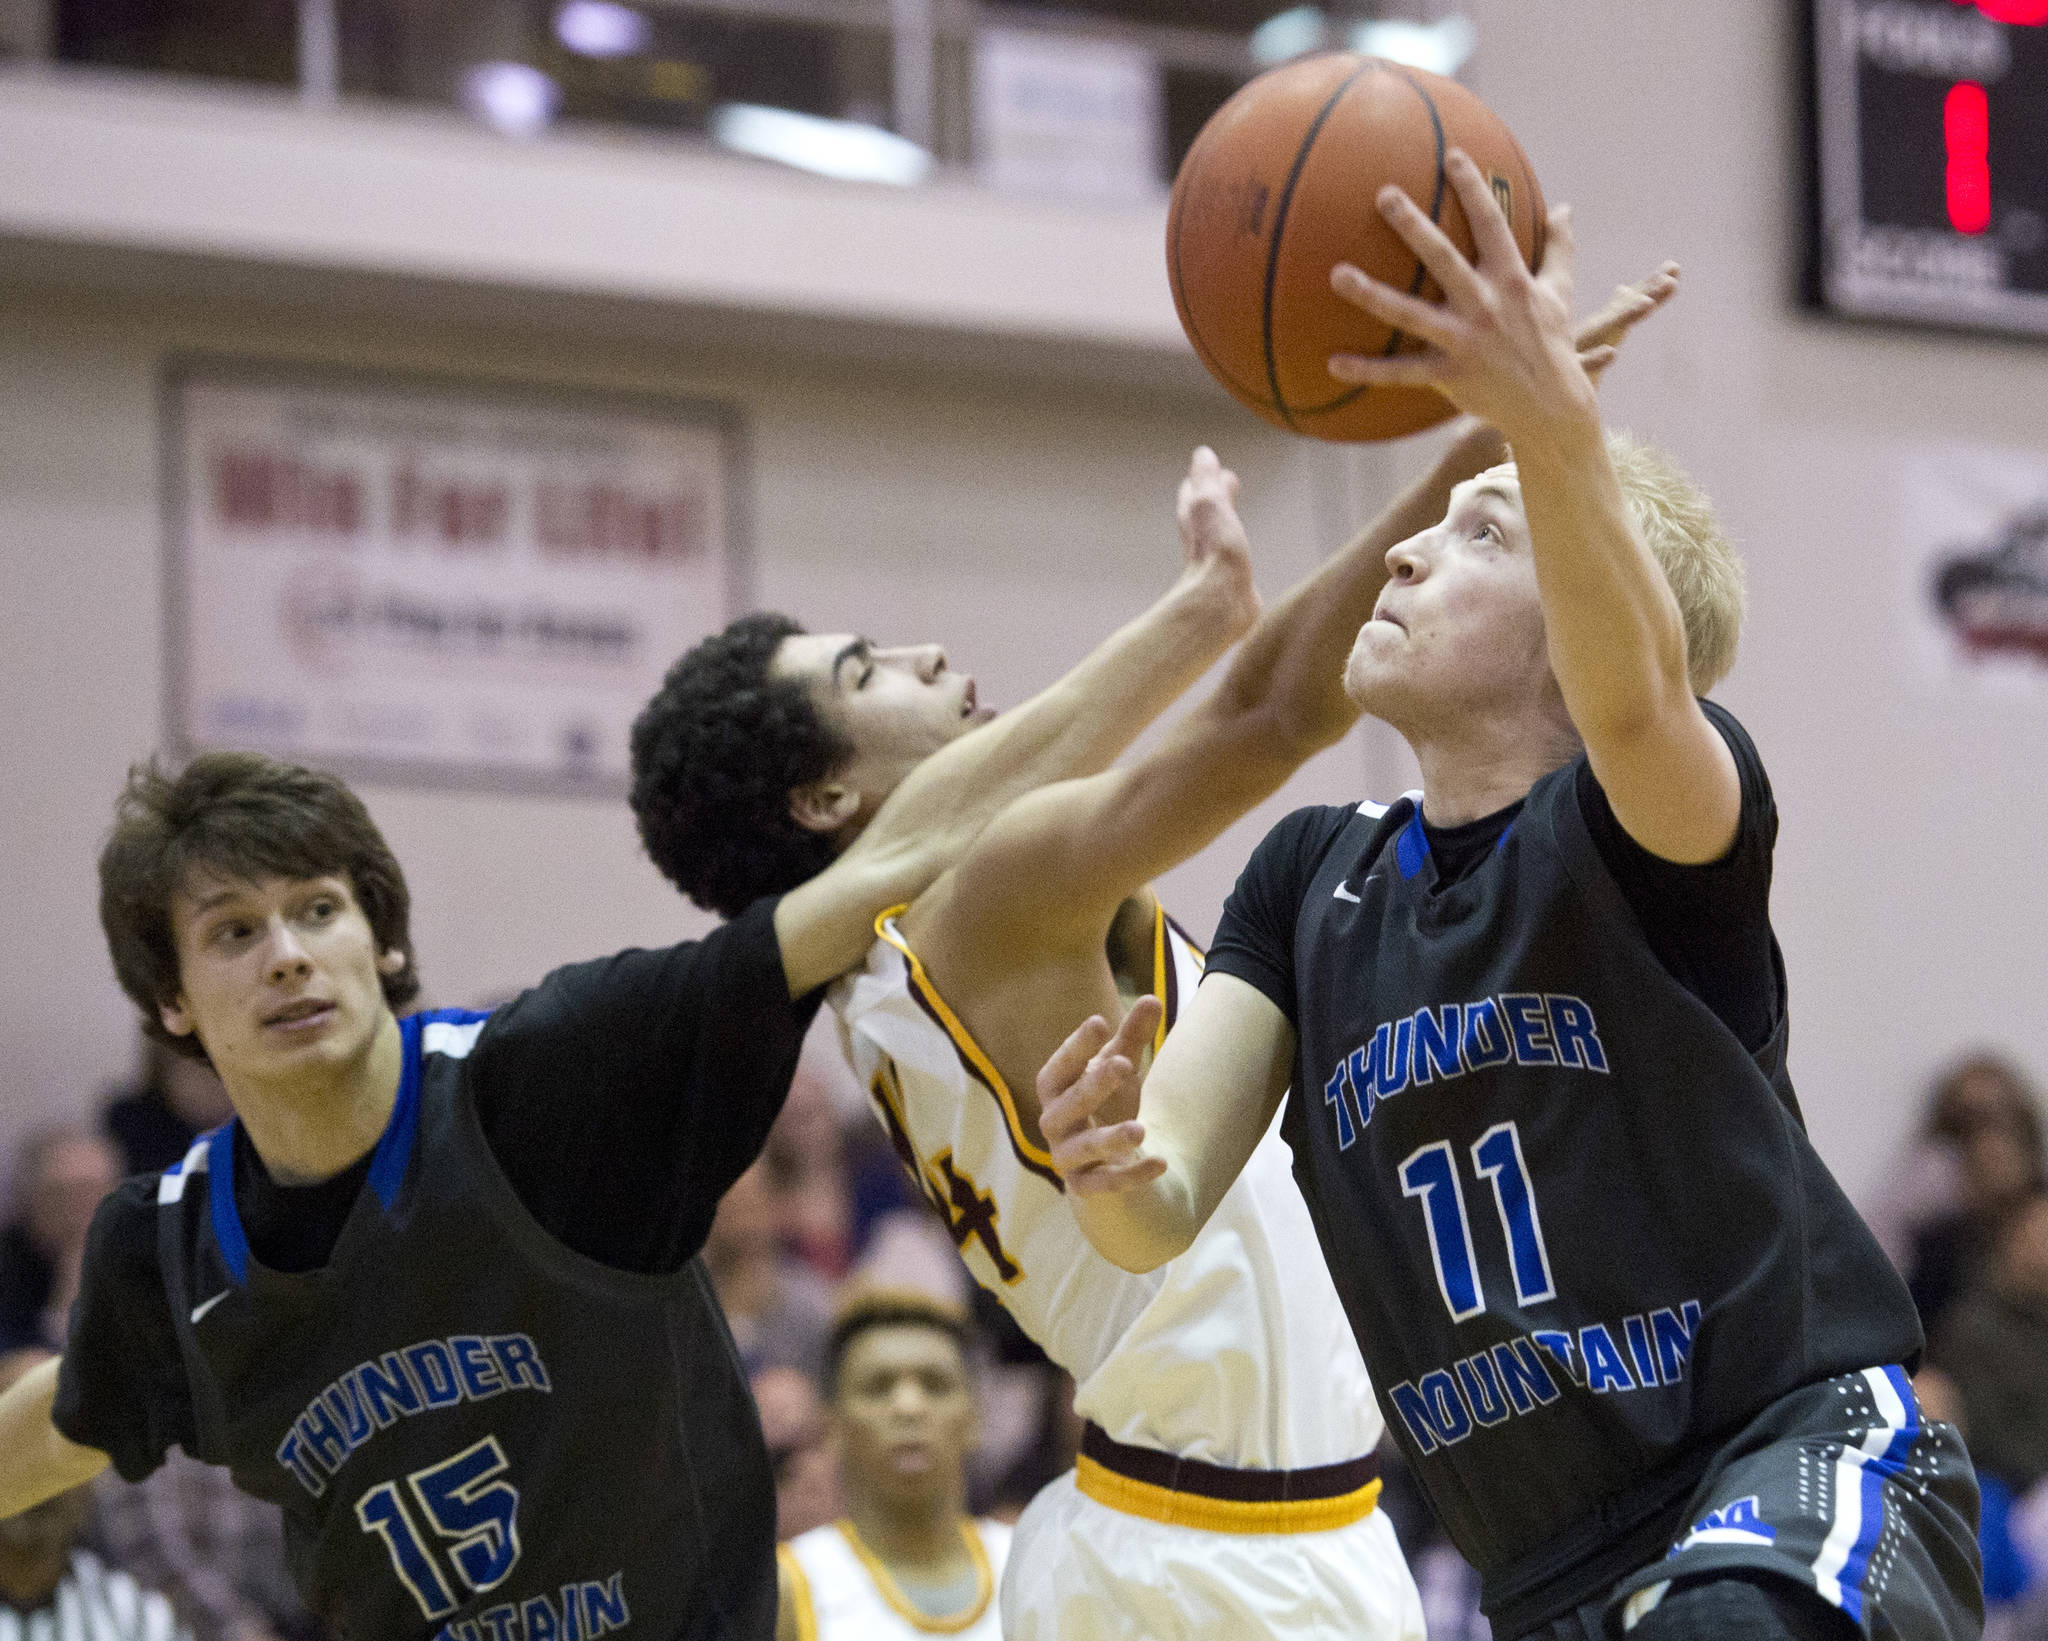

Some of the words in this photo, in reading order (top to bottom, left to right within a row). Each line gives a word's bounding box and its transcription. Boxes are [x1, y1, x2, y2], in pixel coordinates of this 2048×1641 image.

[1324, 993, 1610, 1151] THUNDER
[1398, 1121, 1557, 1324] 11
[275, 1332, 553, 1498] THUNDER
[354, 1434, 521, 1622] 15
